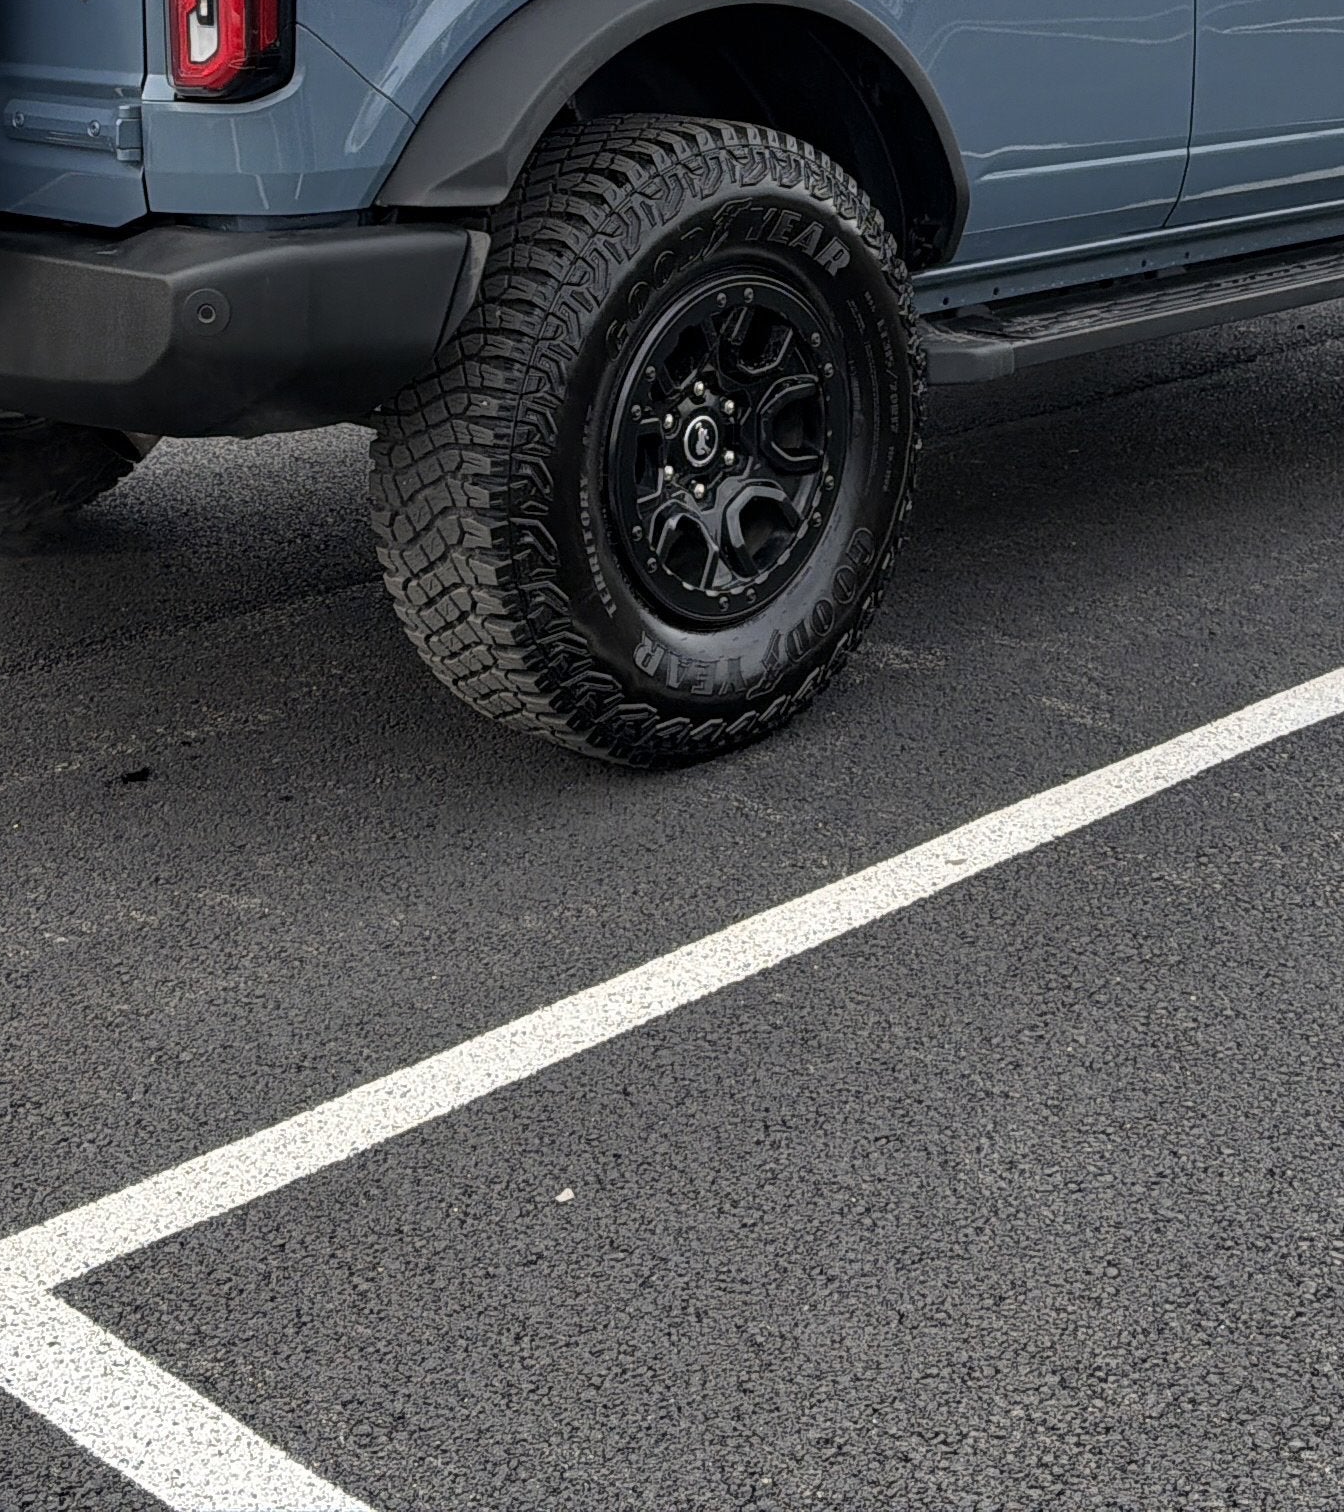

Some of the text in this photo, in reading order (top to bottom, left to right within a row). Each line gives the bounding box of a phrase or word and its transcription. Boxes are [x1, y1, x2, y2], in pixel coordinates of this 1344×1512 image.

[604, 197, 852, 363] GOODYEAR
[579, 472, 617, 619] TERRITORY
[633, 527, 876, 701] GOODYEAR
